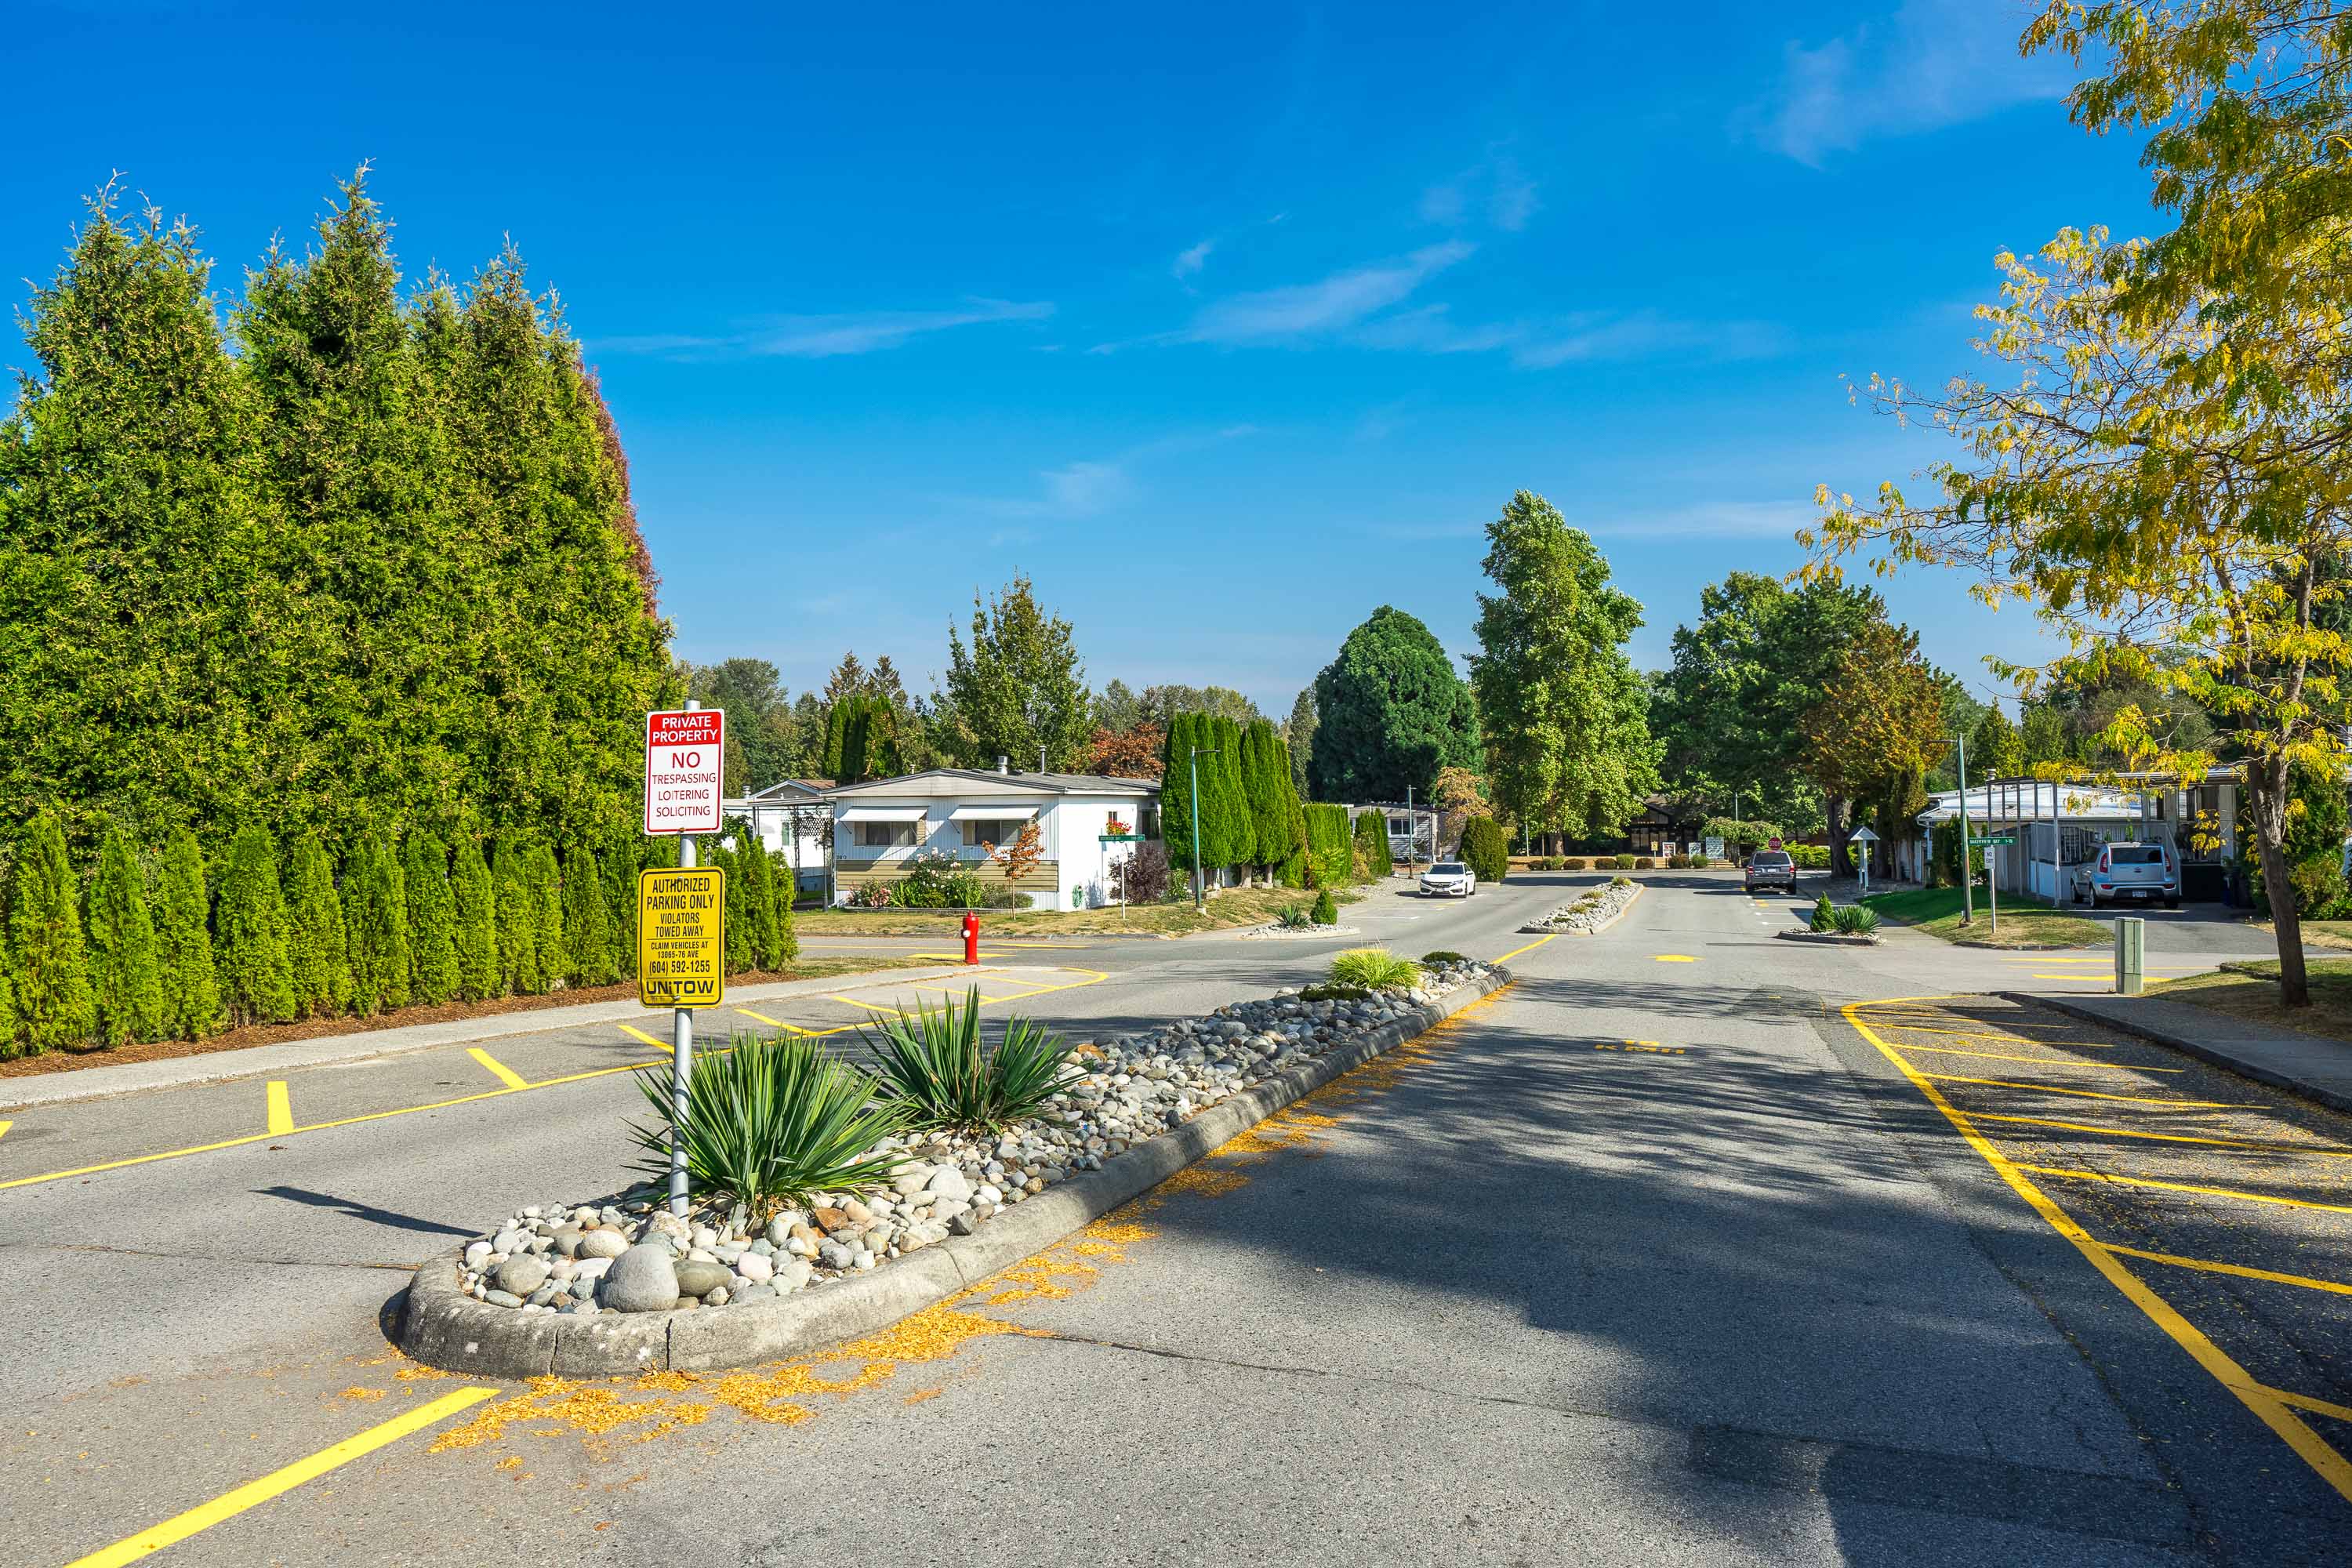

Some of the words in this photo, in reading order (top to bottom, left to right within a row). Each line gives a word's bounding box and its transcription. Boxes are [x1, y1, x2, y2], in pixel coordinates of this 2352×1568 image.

[662, 716, 712, 728] PRIVATE
[652, 729, 718, 743] PROPERTY
[672, 752, 700, 768] NO
[652, 772, 716, 785] TRESPASSING
[658, 789, 709, 801] LOITERING
[656, 805, 710, 817] SOLICITING
[652, 877, 710, 893] AUTHORIZED
[647, 895, 686, 910] PARKING
[689, 894, 715, 909] ONLY
[660, 912, 700, 924] VIOLATORS
[655, 926, 681, 938] TOWED
[682, 925, 704, 937] AWAY
[651, 942, 669, 950] CLAIM
[671, 941, 699, 949] VEHICLES
[649, 960, 669, 976] (604)
[671, 960, 710, 973] 592-1255
